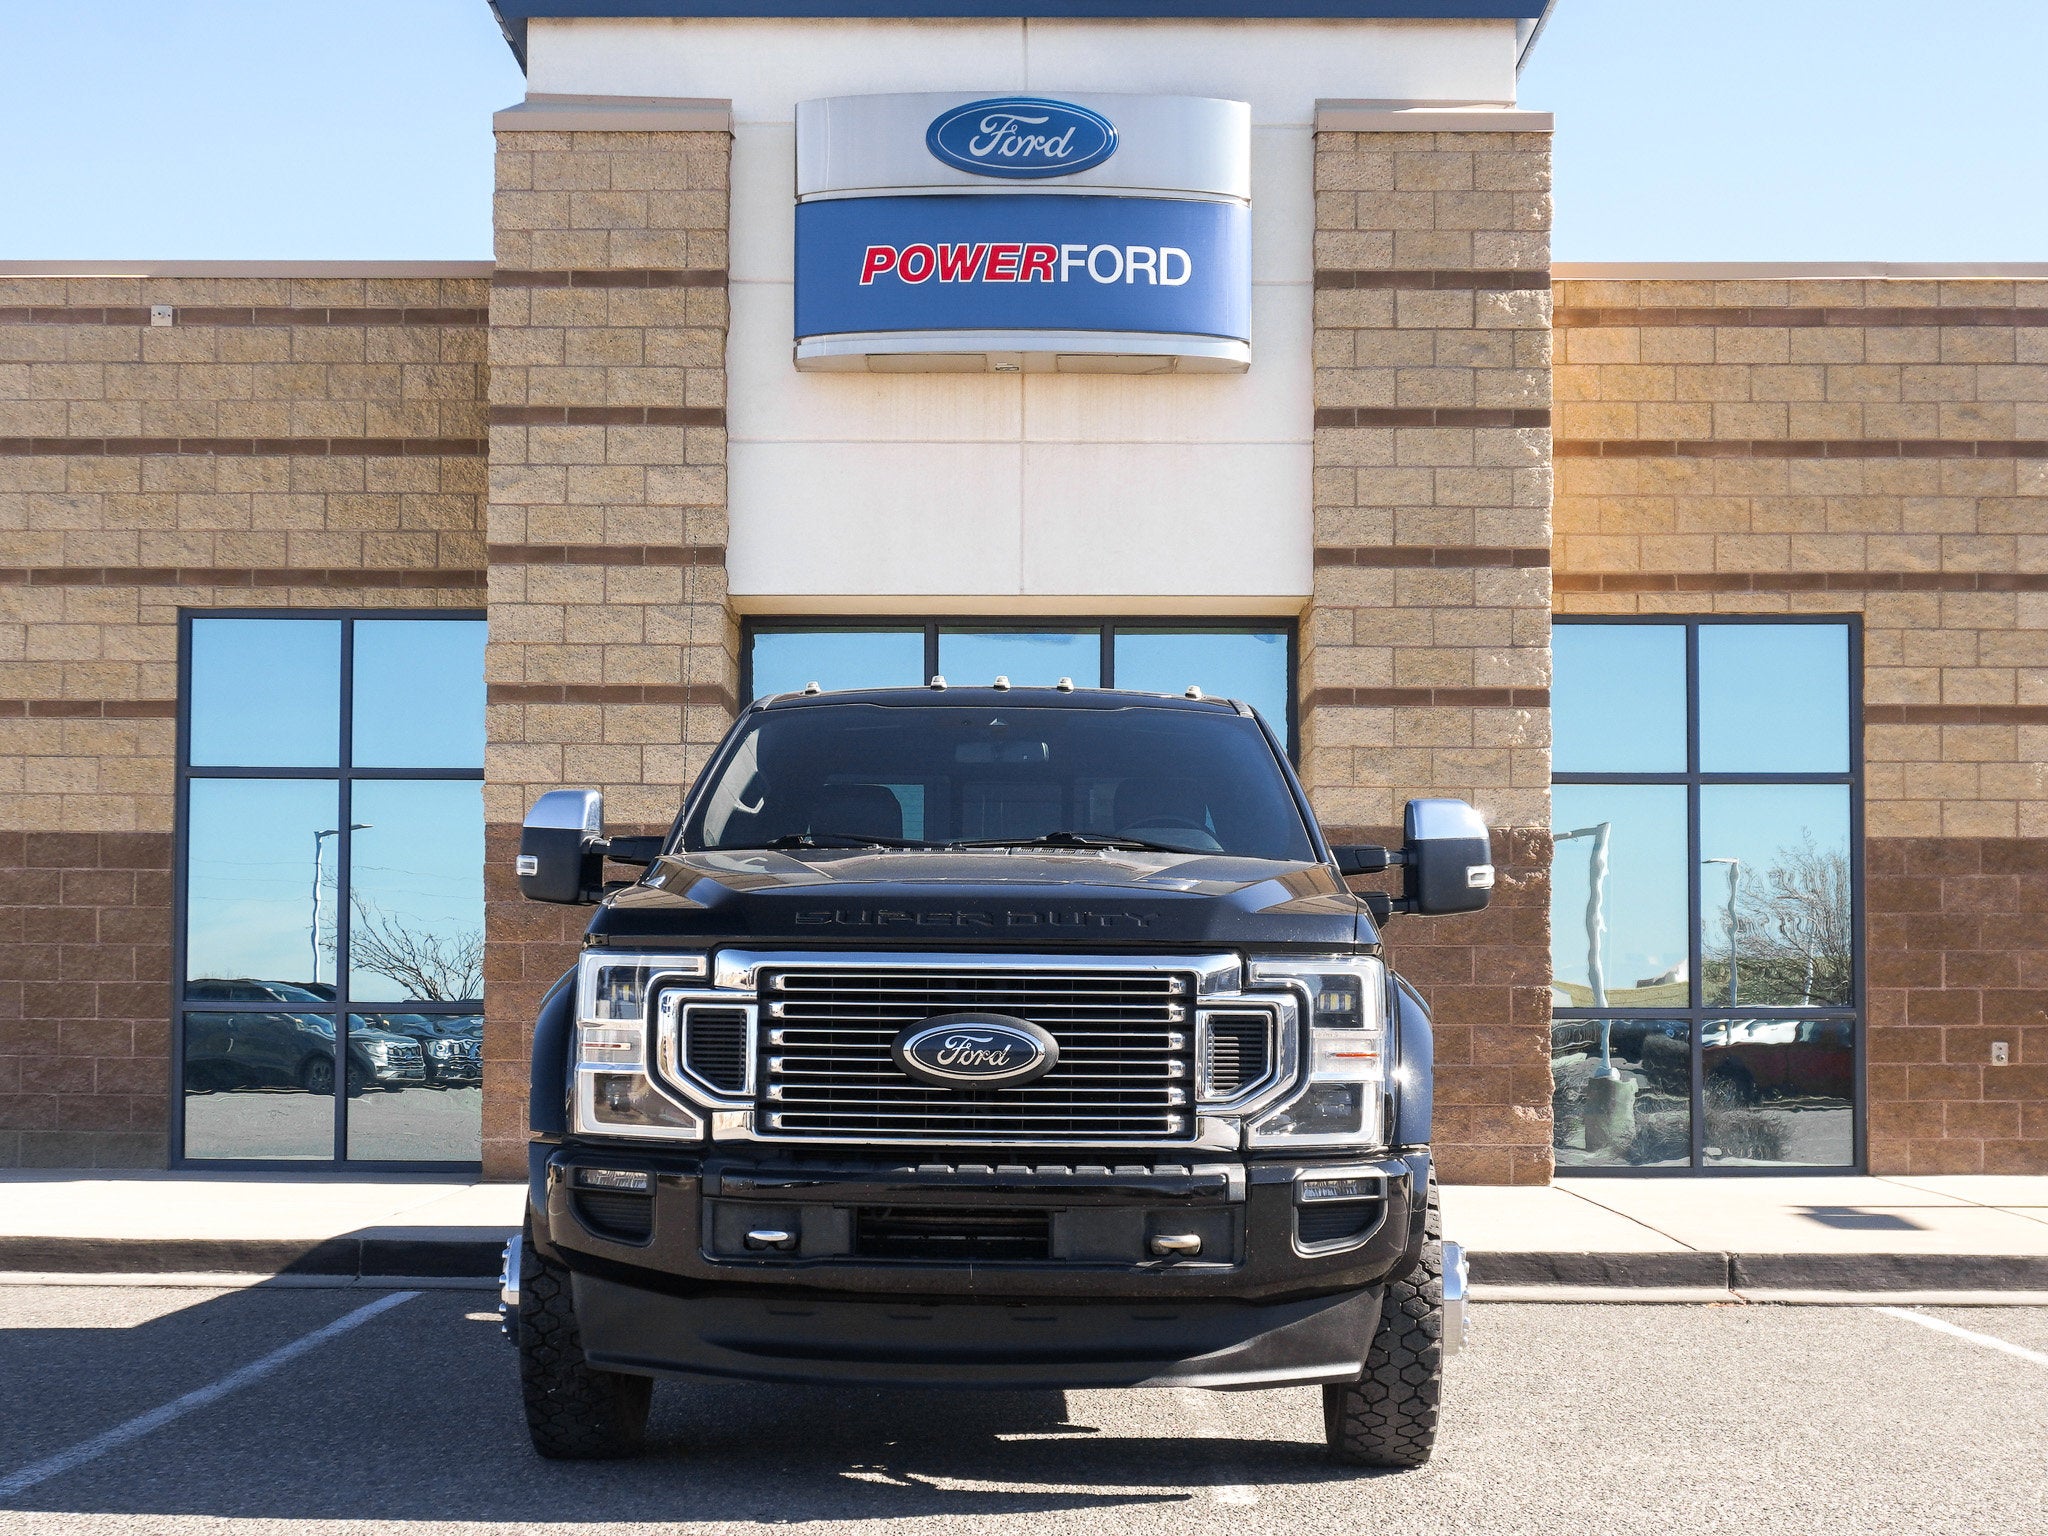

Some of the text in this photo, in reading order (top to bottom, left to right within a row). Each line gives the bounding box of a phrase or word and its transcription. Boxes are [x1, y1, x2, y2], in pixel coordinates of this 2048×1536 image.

[969, 112, 1075, 159] Ford
[794, 910, 1160, 927] SUPER DUTY
[936, 1034, 1011, 1067] Ford
